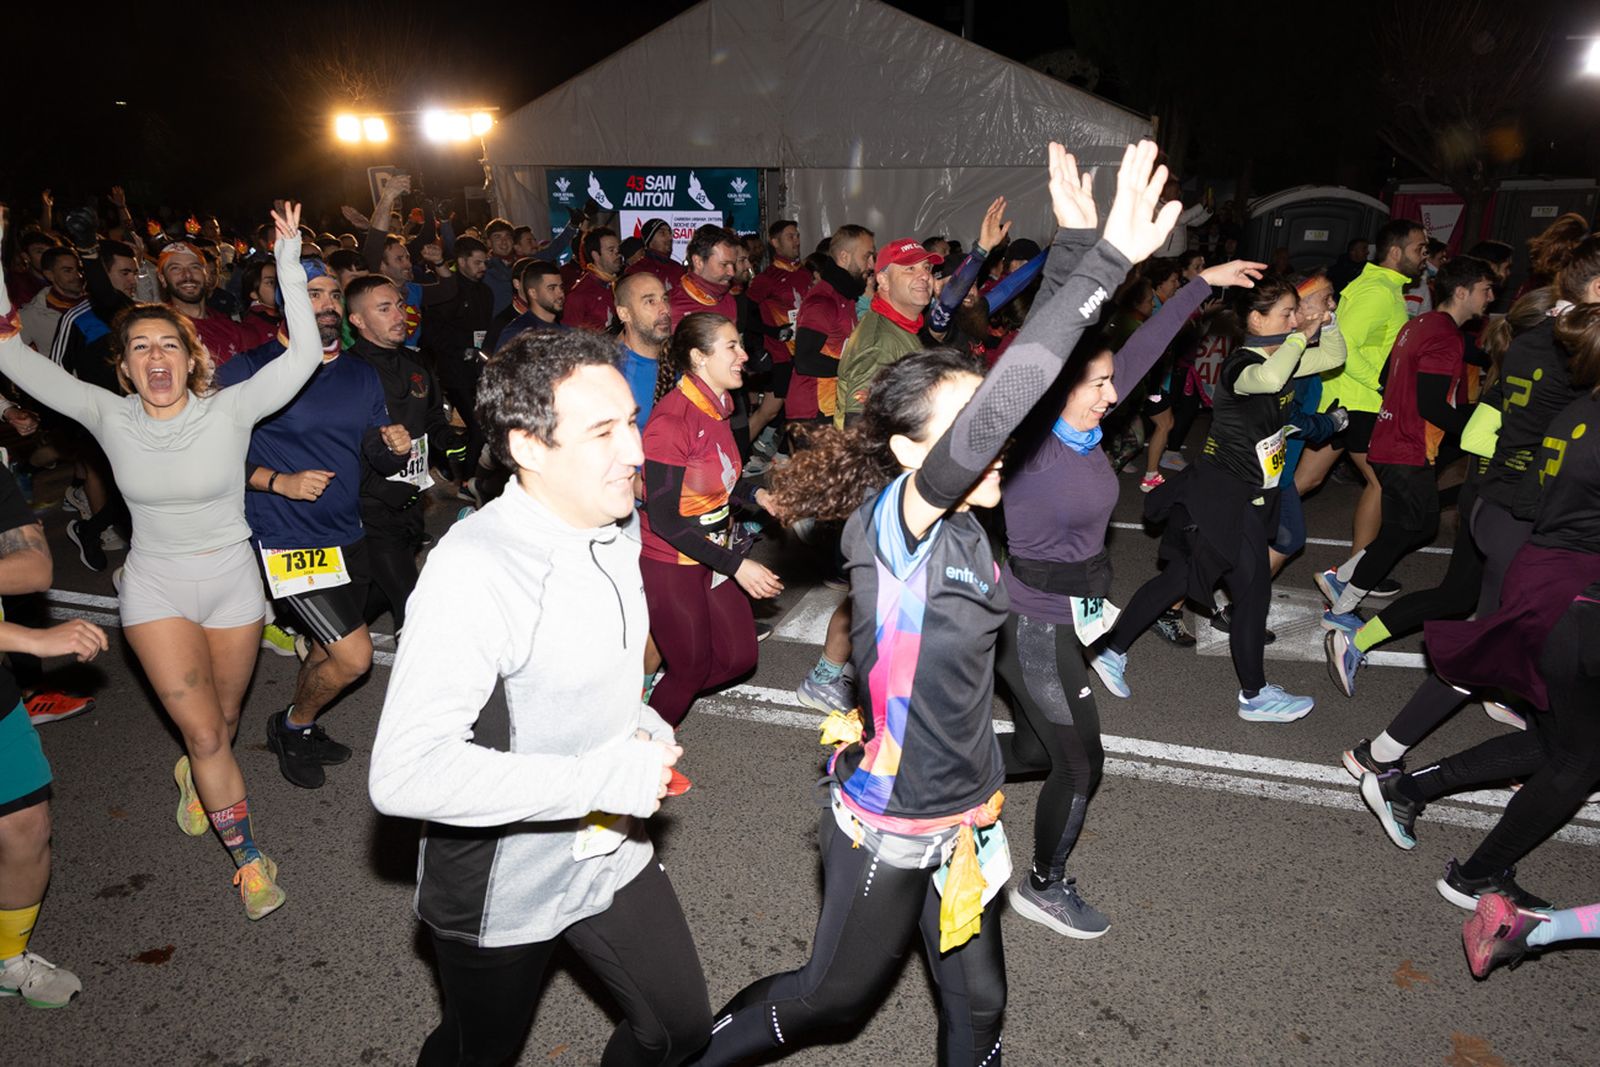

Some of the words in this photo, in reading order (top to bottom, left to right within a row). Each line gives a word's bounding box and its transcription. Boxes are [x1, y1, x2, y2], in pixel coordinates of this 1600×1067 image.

[626, 175, 645, 192] 43
[645, 175, 677, 191] SAN
[595, 191, 605, 204] 43
[623, 188, 675, 208] ANTÓN
[695, 192, 706, 205] 43
[281, 549, 328, 573] 7372
